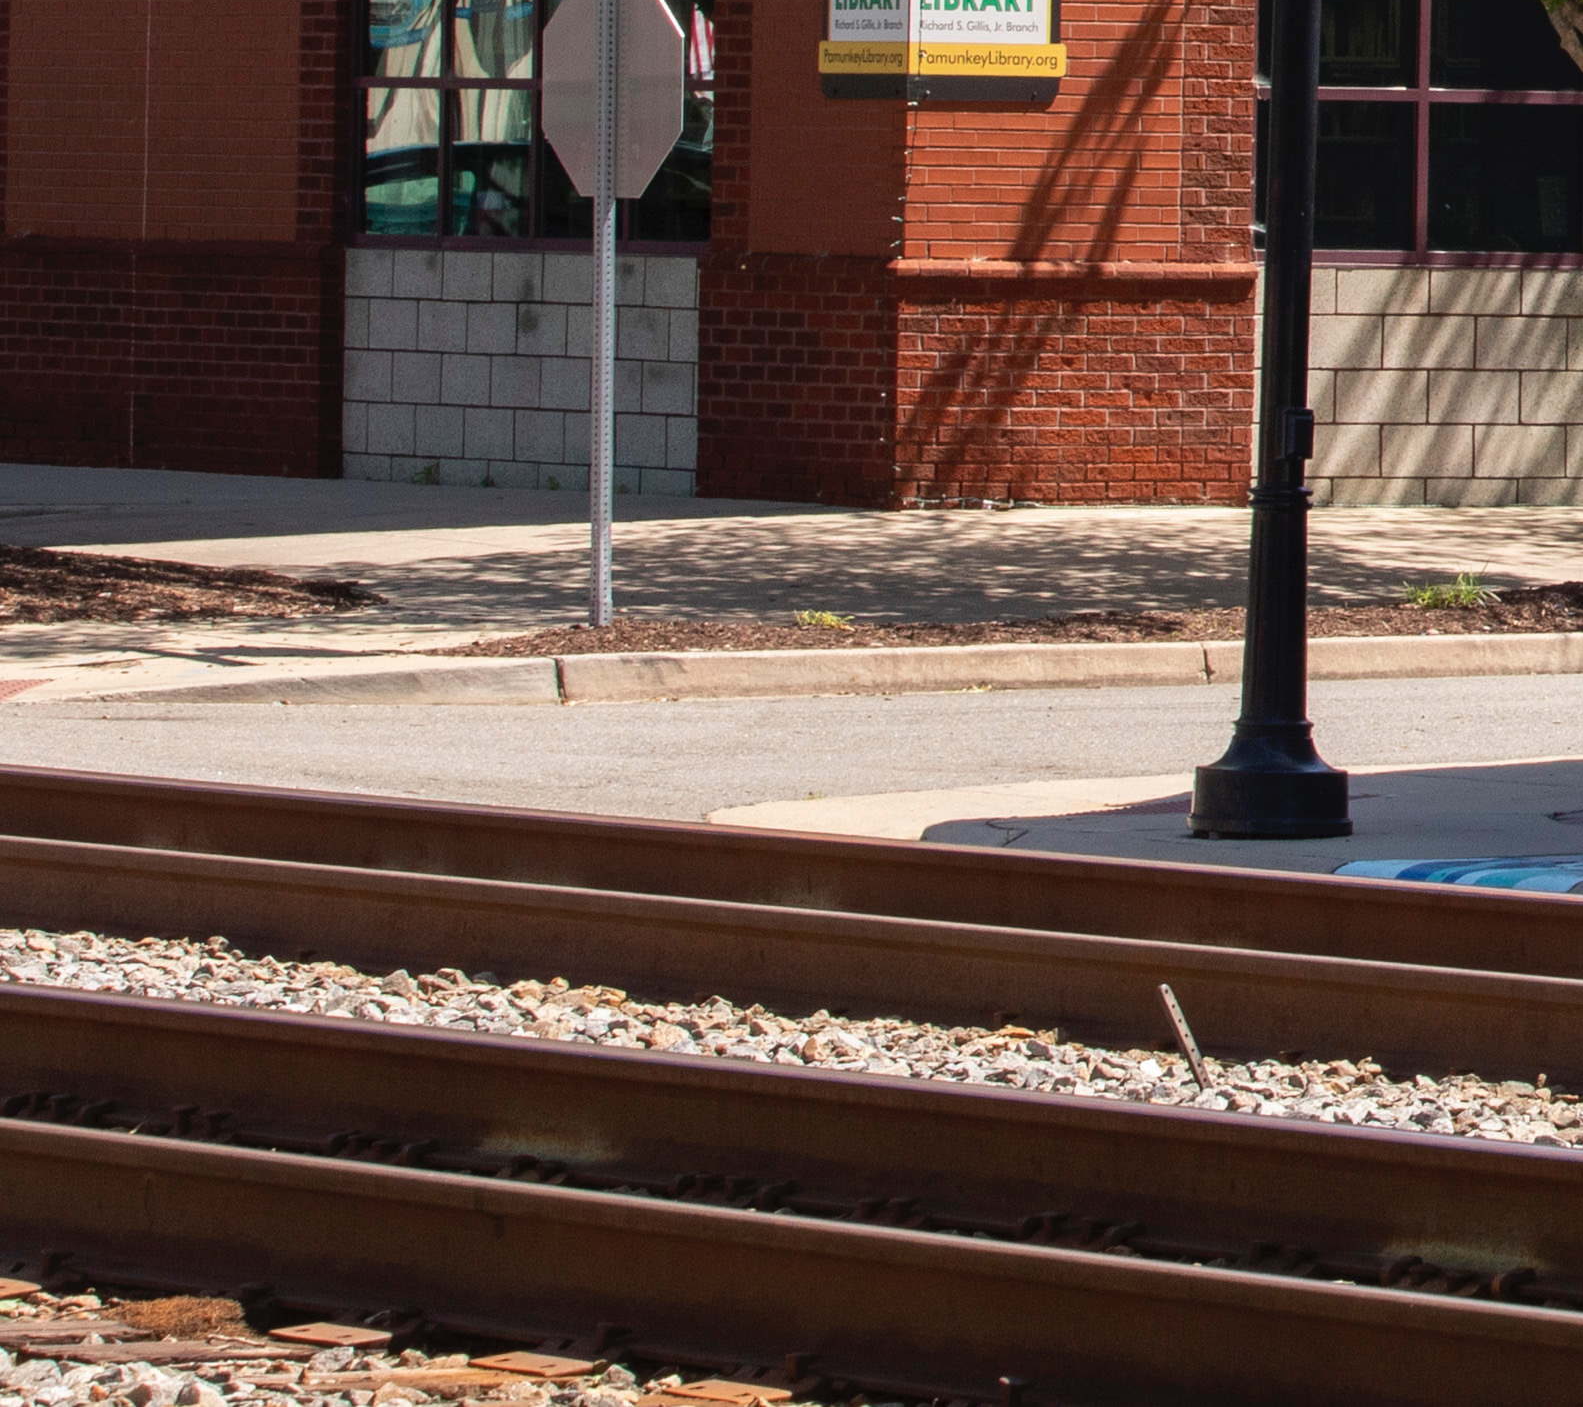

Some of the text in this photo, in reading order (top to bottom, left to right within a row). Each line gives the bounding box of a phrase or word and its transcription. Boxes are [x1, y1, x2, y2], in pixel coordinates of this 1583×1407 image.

[835, 19, 855, 30] Richard
[884, 20, 903, 30] Branch
[920, 19, 1038, 33] Richard S. Gillis, Jr. Branch
[824, 48, 903, 66] PamunkeyLibrary.org
[919, 50, 1058, 69] PamunkeyLibrary.org
